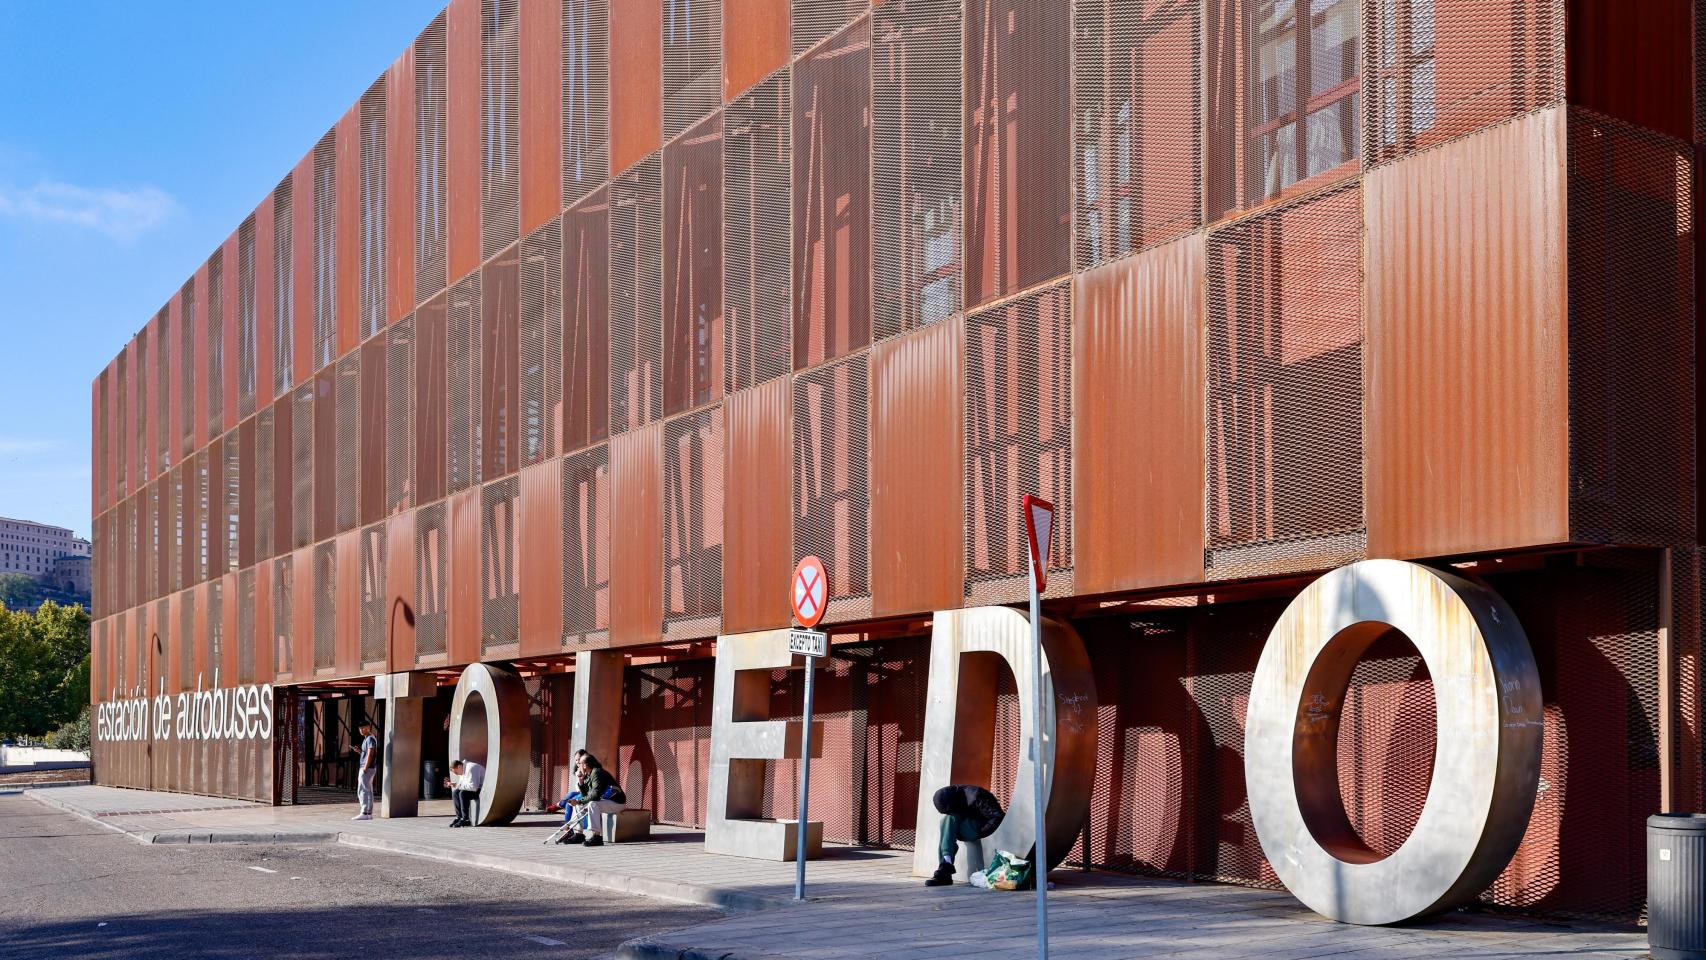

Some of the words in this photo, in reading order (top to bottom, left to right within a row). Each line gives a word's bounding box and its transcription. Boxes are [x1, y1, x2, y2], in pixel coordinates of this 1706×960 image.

[790, 633, 811, 651] EXCEPTO
[812, 635, 823, 653] TAXI
[98, 685, 148, 741] estación
[153, 676, 171, 741] de
[176, 667, 272, 741] autobuses
[374, 559, 1543, 926] TOLEDO
